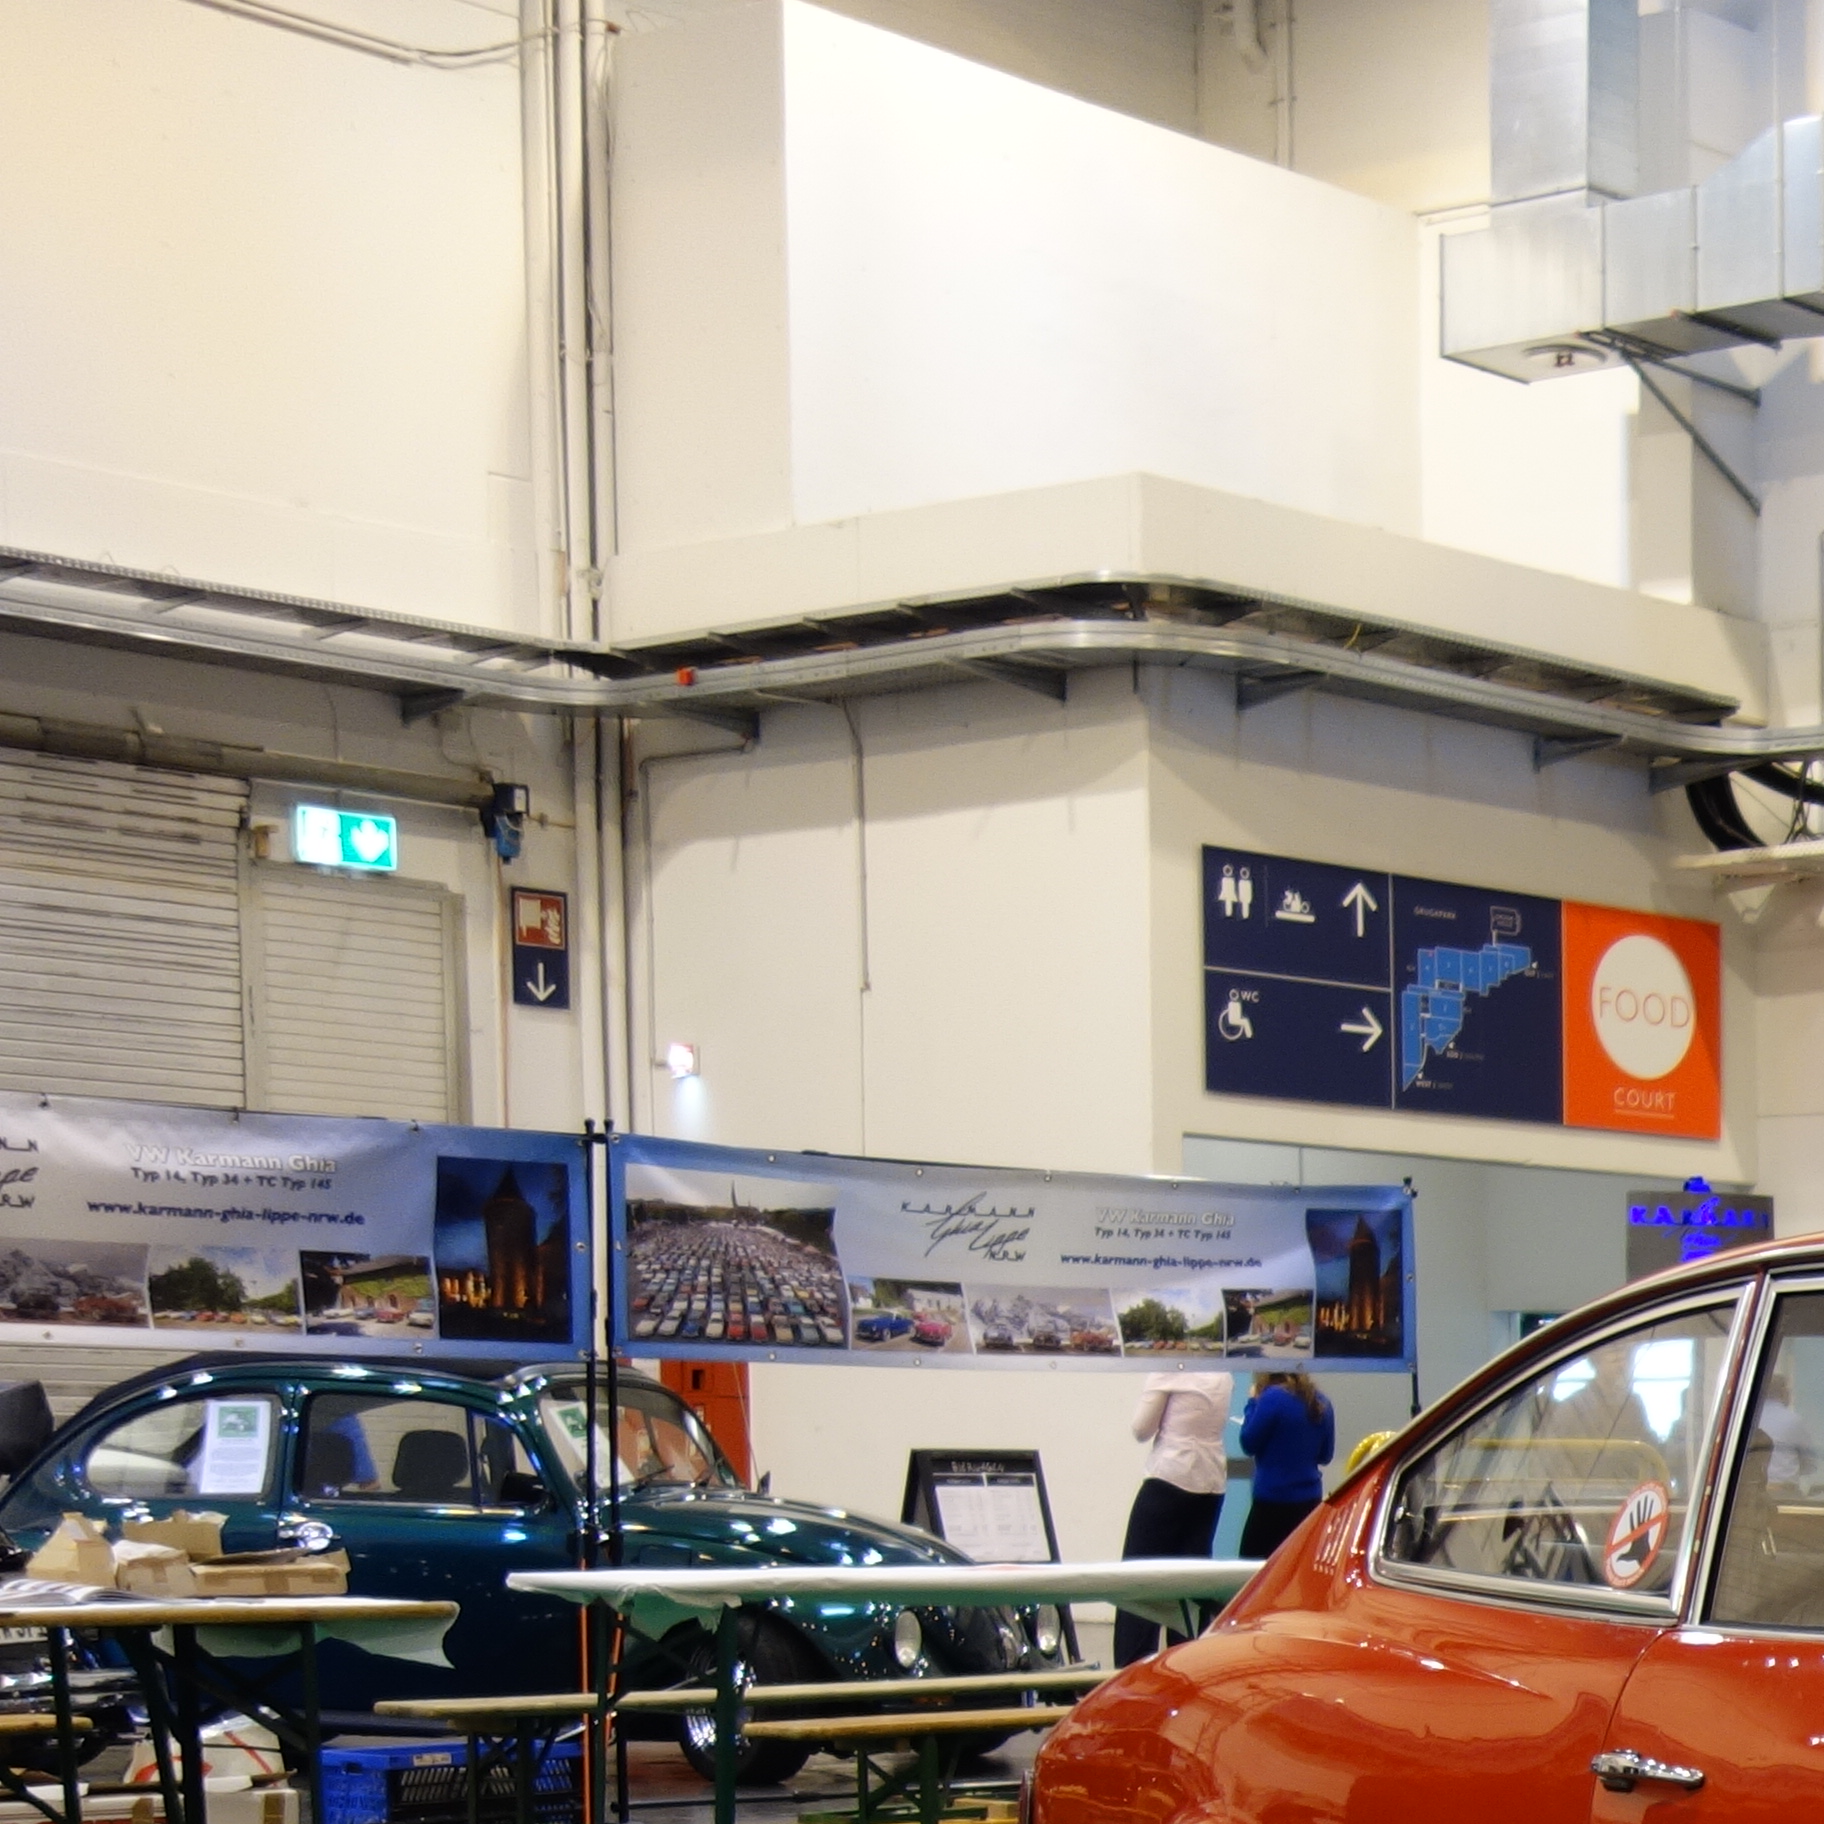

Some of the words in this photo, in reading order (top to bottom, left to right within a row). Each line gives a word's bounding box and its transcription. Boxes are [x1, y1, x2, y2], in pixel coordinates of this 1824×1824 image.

[1241, 990, 1260, 1003] WC
[1599, 986, 1690, 1028] FOOD
[1613, 1086, 1677, 1113] COURT
[126, 1143, 171, 1163] VW
[176, 1146, 284, 1170] Karmann
[287, 1154, 338, 1174] Ghia
[131, 1167, 159, 1182] Typ
[191, 1170, 219, 1187] Typ
[256, 1174, 277, 1188] TC
[281, 1176, 306, 1191] Typ
[86, 1200, 366, 1225] www.karmann-ghia-lippe-nrw.de
[1096, 1206, 1128, 1223] VW
[1130, 1208, 1197, 1225] Karmann
[1201, 1211, 1236, 1228] Ghia
[1094, 1226, 1114, 1239] Typ
[1134, 1228, 1151, 1241] Typ
[1177, 1229, 1191, 1239] TC
[1194, 1229, 1213, 1242] Typ
